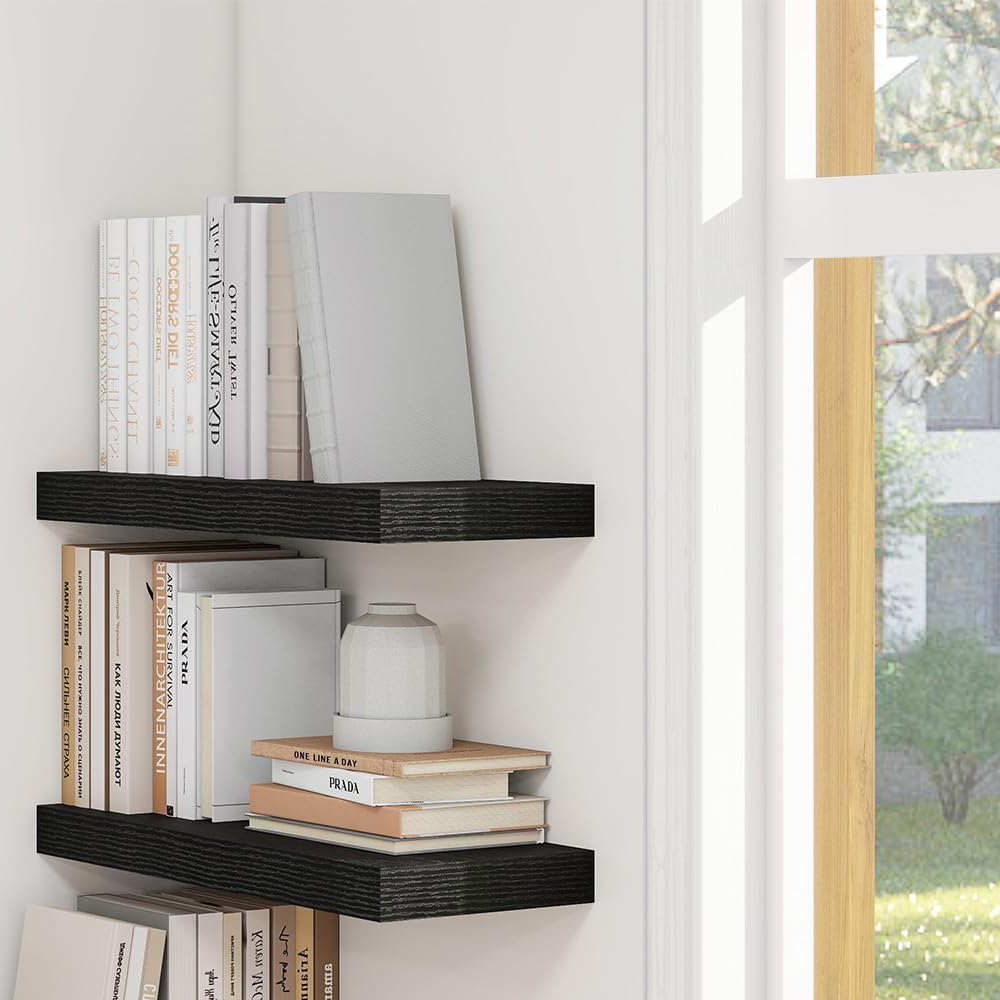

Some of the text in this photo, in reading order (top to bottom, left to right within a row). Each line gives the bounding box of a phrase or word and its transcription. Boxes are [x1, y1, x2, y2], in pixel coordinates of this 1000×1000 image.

[156, 562, 166, 774] INNENARCHITEKTUR
[114, 731, 122, 787] ДУМАЮТ
[294, 750, 358, 768] ONE LINE A DAY
[329, 776, 359, 795] PRADA
